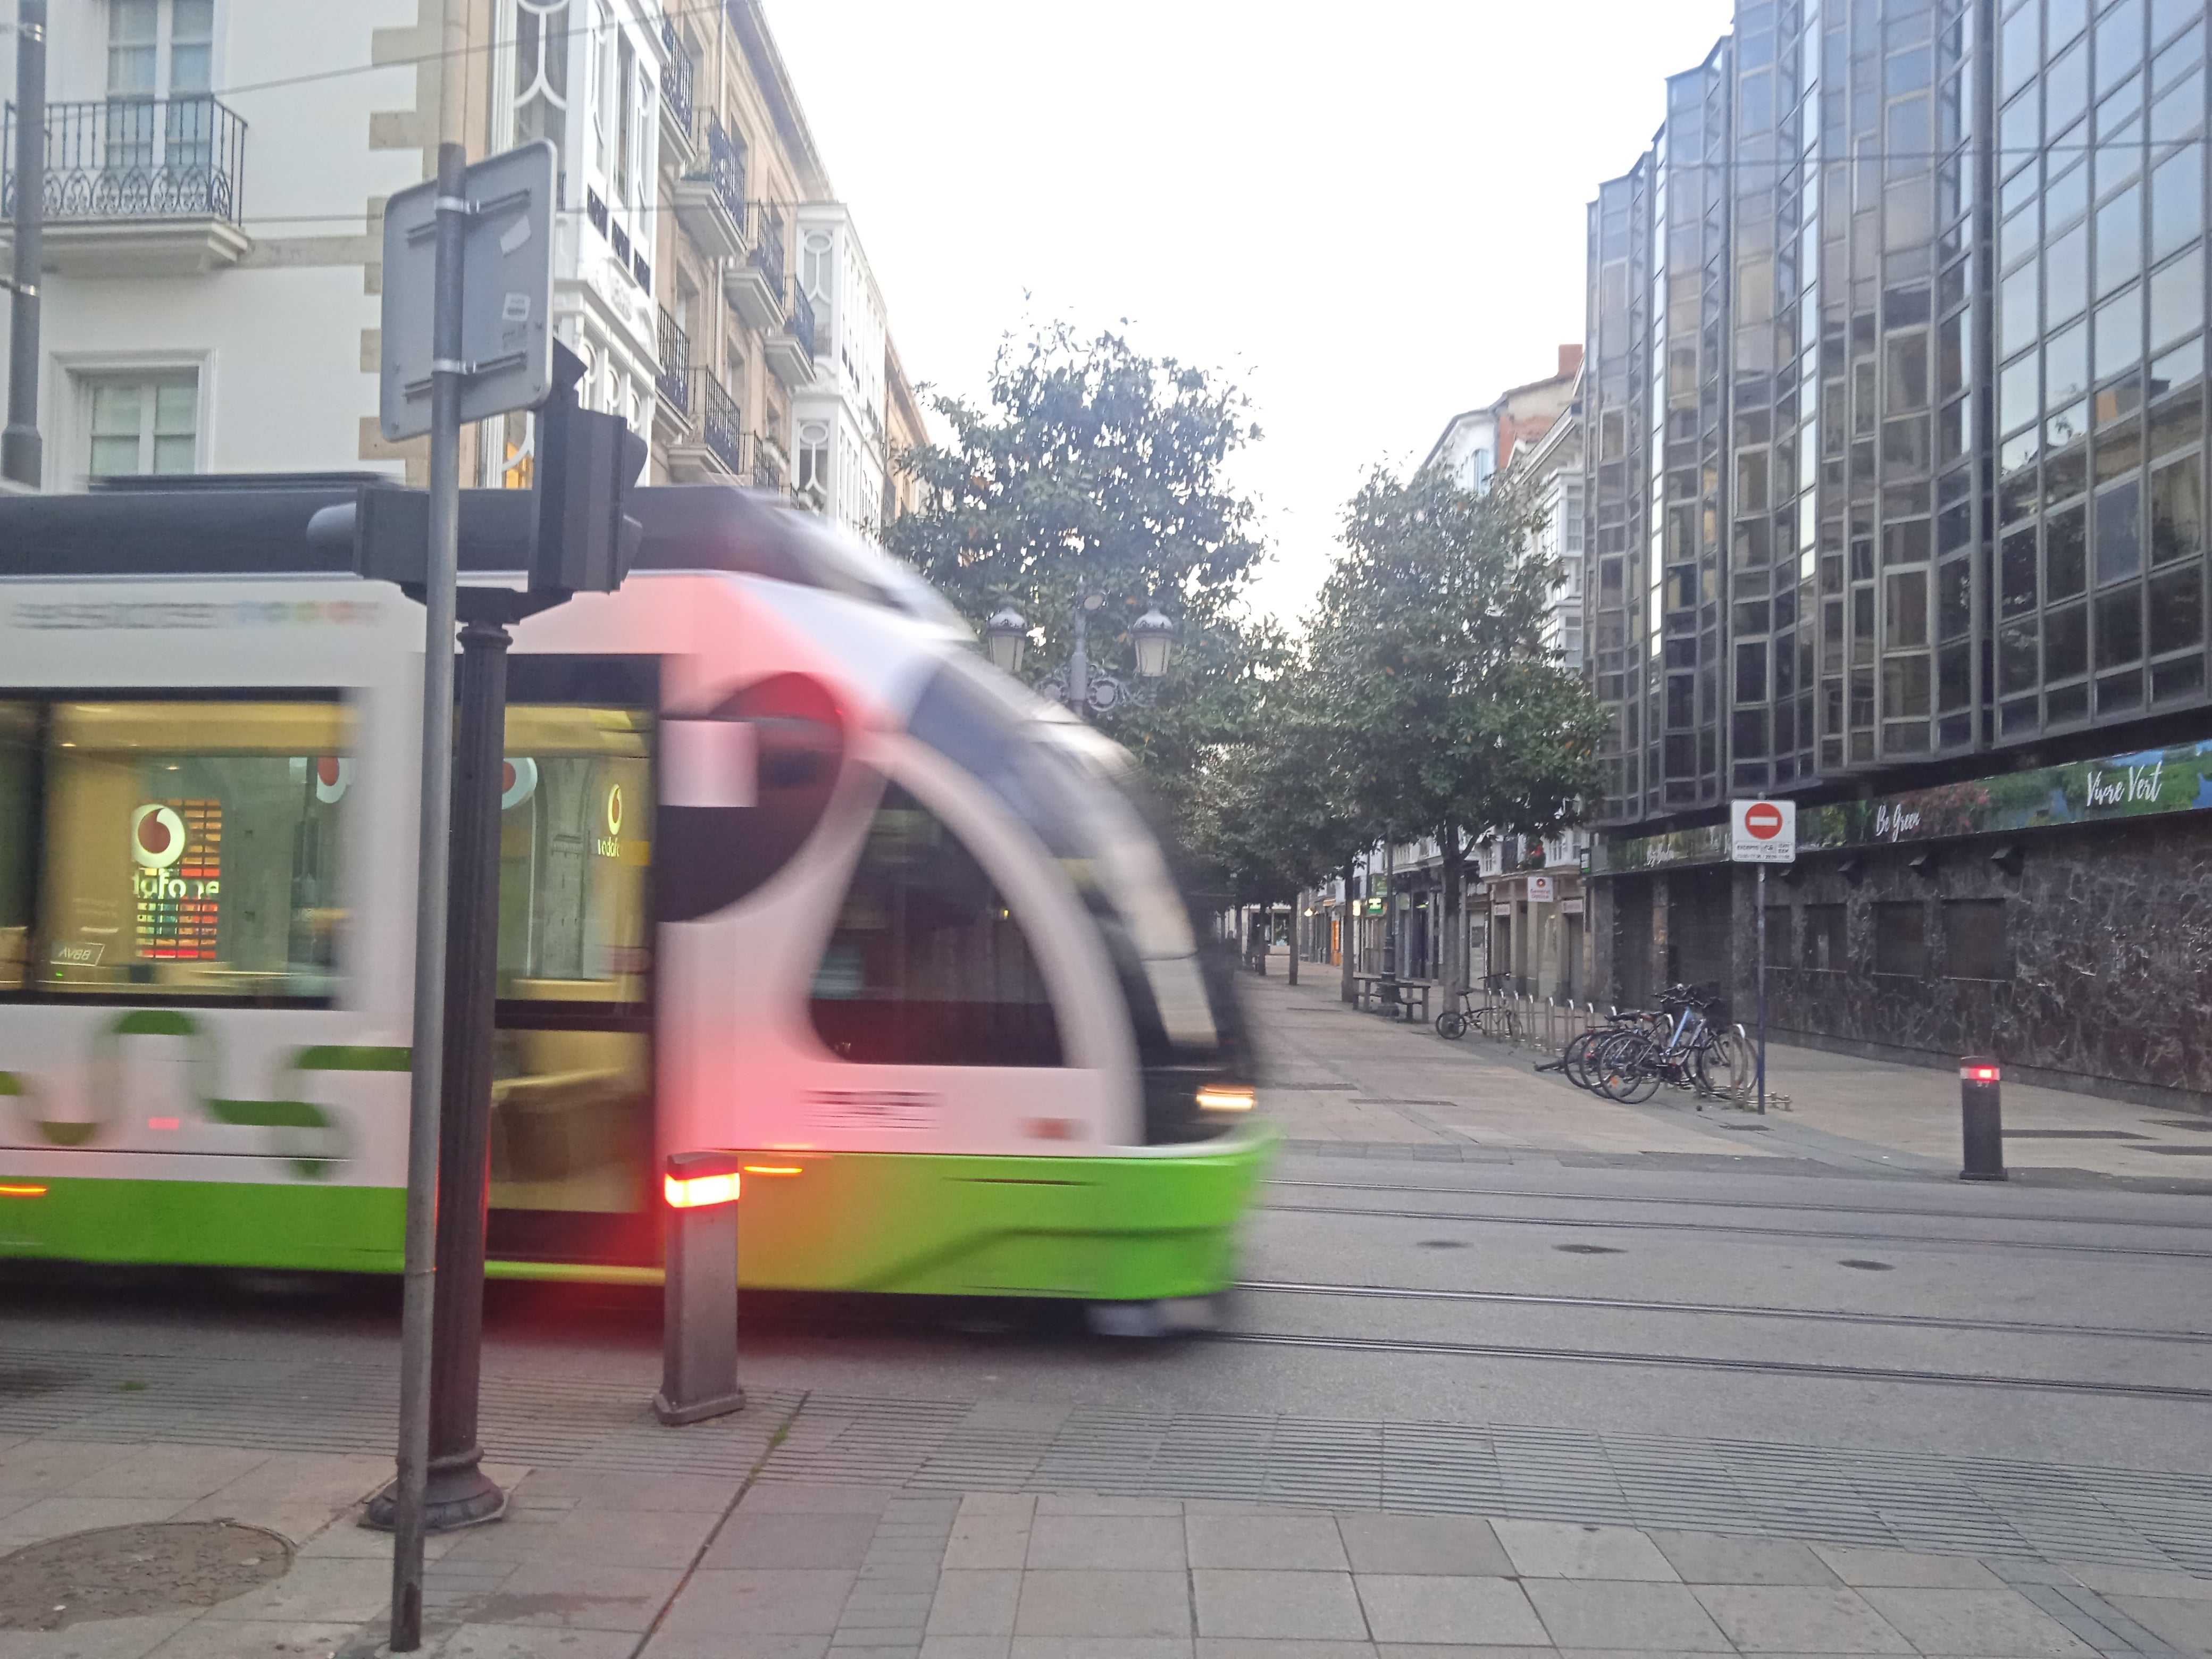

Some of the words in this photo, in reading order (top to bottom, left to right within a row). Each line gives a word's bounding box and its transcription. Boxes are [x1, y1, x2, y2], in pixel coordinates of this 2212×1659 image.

[2087, 770, 2125, 807] Vivre
[2127, 760, 2163, 802] Vert
[1875, 805, 1890, 836] Be
[1892, 803, 1921, 842] Green
